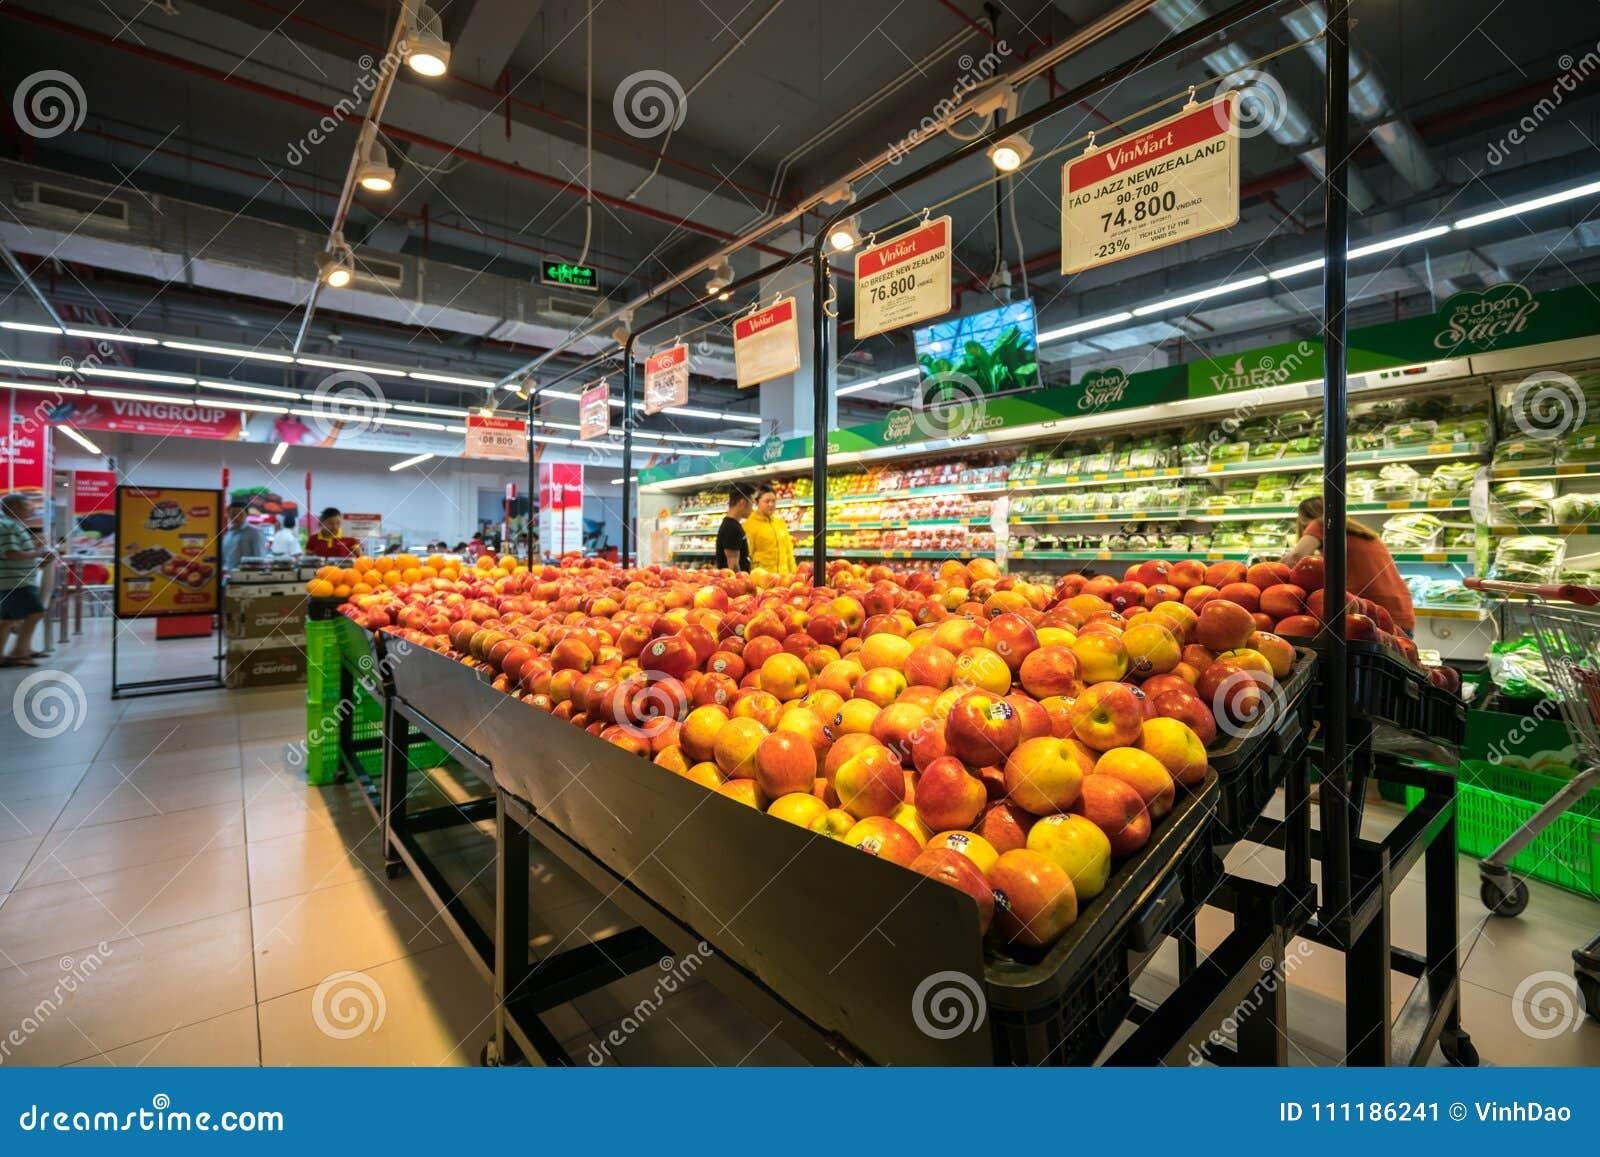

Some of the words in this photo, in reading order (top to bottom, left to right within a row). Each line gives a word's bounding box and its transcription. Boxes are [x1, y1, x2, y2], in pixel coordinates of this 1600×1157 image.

[1106, 131, 1174, 172] VinMart
[1094, 179, 1124, 199] JAZZ
[1127, 139, 1226, 187] NEWZEALAND
[1116, 180, 1159, 206] 90.700
[1101, 190, 1176, 233] 74.800
[879, 239, 917, 266] VinMart
[1094, 237, 1131, 259] -23%
[895, 264, 911, 277] NEW
[912, 250, 945, 270] ZEALAND
[870, 274, 916, 304] 76.800
[110, 400, 226, 423] VINGROUP
